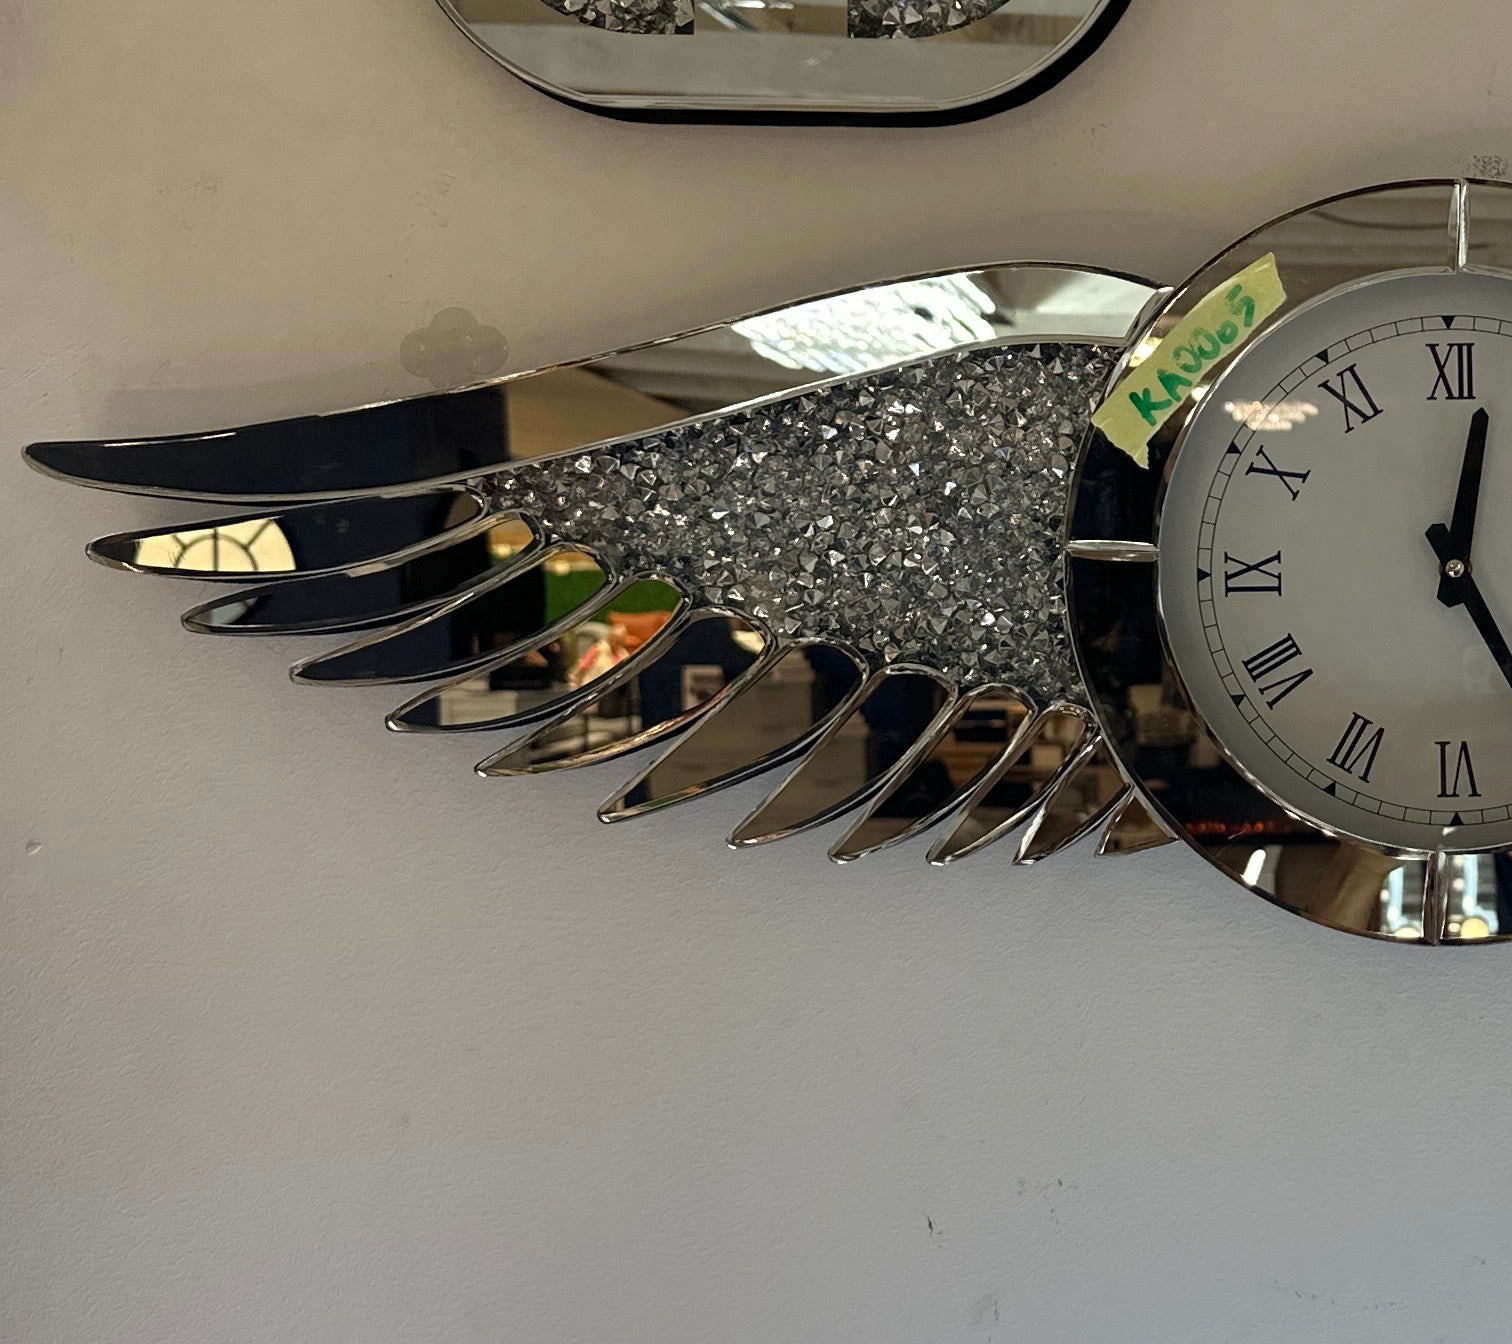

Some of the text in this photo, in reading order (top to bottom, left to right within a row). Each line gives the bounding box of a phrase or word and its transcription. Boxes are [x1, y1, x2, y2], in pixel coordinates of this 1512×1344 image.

[1318, 363, 1384, 433] XI
[1425, 342, 1476, 400] XII
[1245, 444, 1310, 501] X
[1223, 550, 1282, 598] IX
[1242, 632, 1314, 710] VIII
[1326, 712, 1385, 784] VII
[1435, 740, 1483, 799] VI
